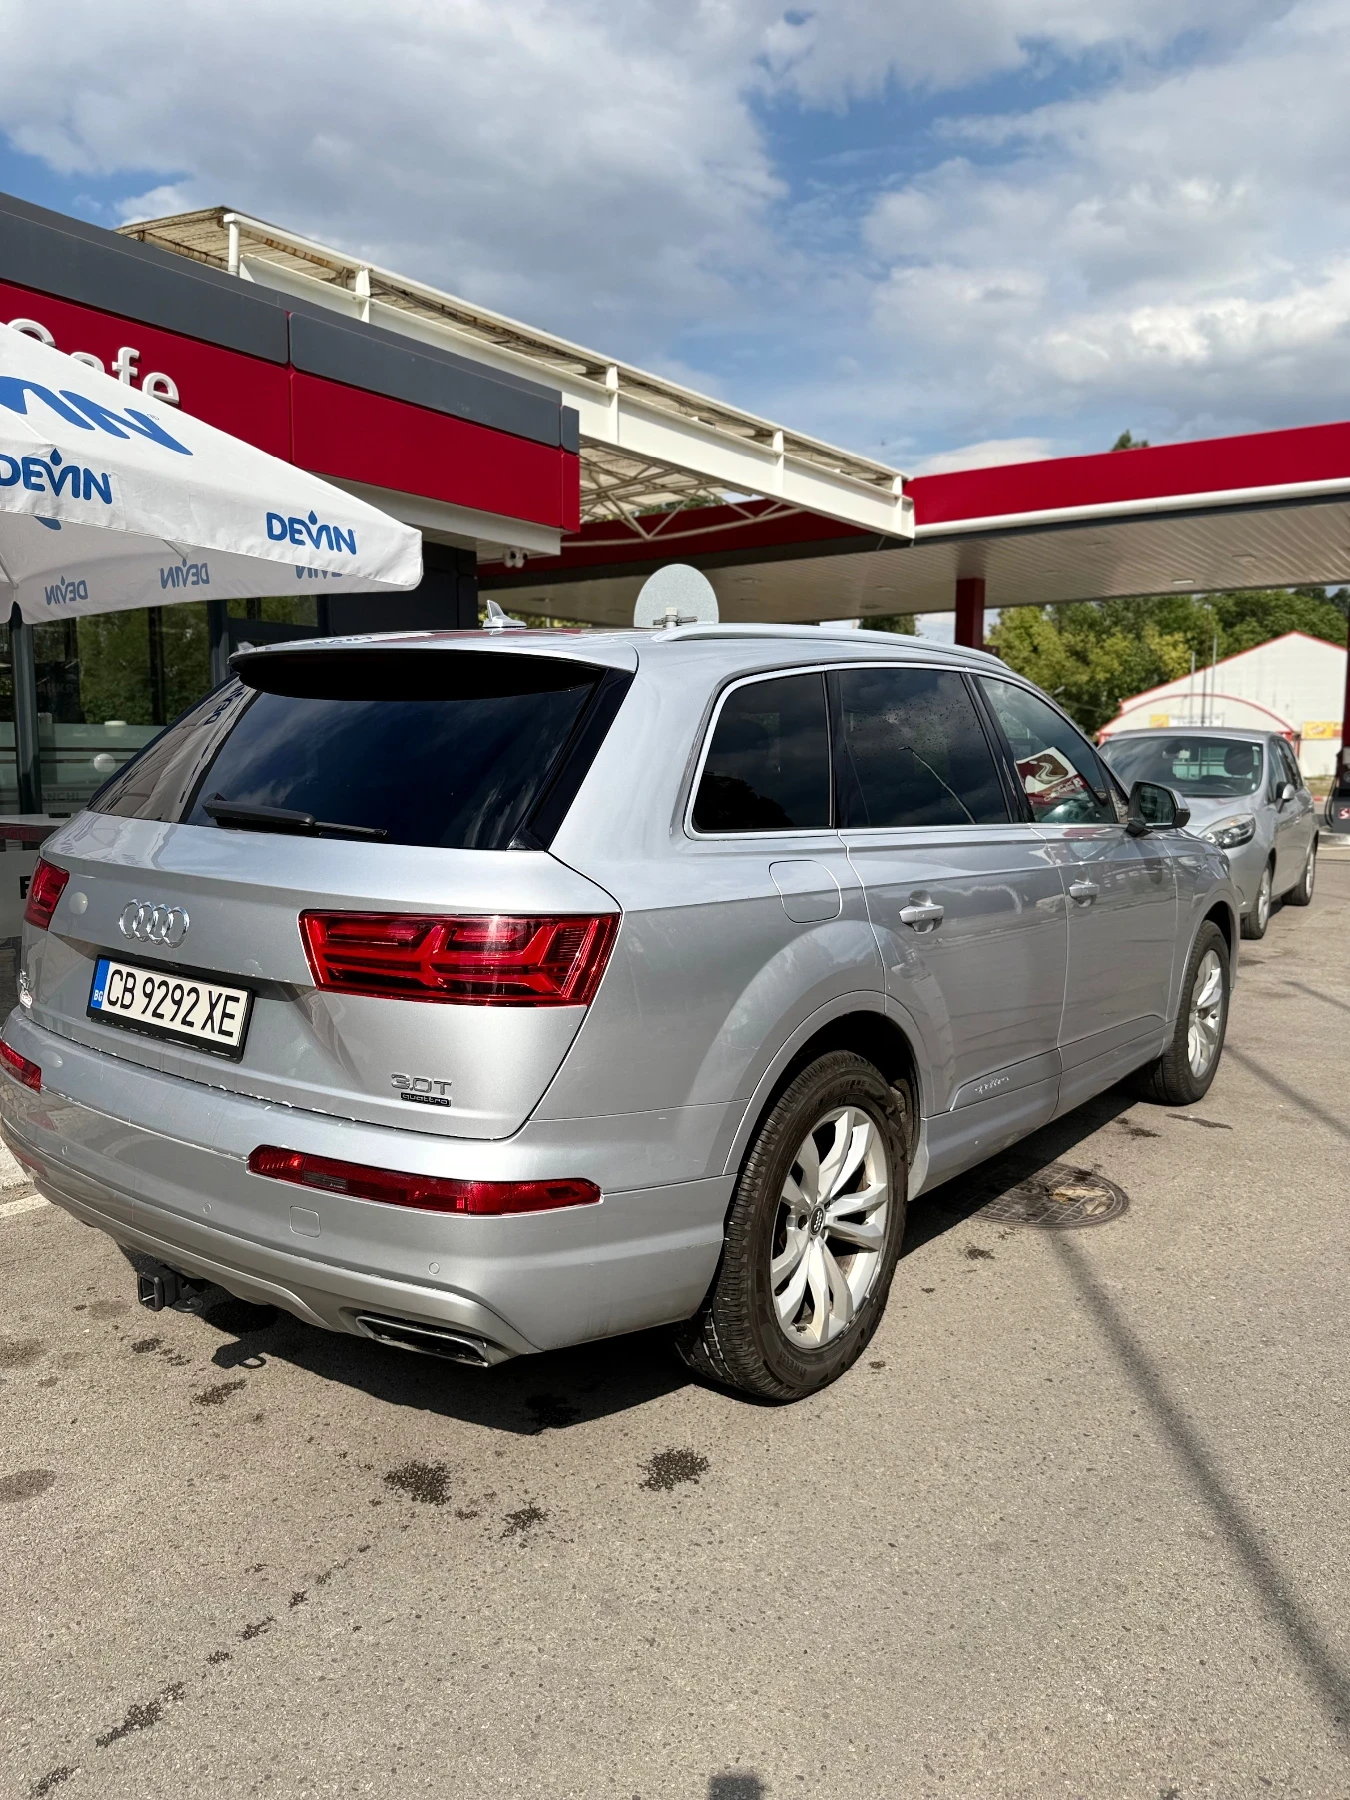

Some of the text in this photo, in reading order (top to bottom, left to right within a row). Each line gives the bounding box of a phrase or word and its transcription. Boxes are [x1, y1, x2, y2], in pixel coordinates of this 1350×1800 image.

[0, 453, 113, 504] DEVIN
[266, 511, 357, 555] DEVIN
[94, 989, 104, 1001] BG
[106, 968, 241, 1038] CB 9292 XE
[402, 1093, 448, 1106] quattro
